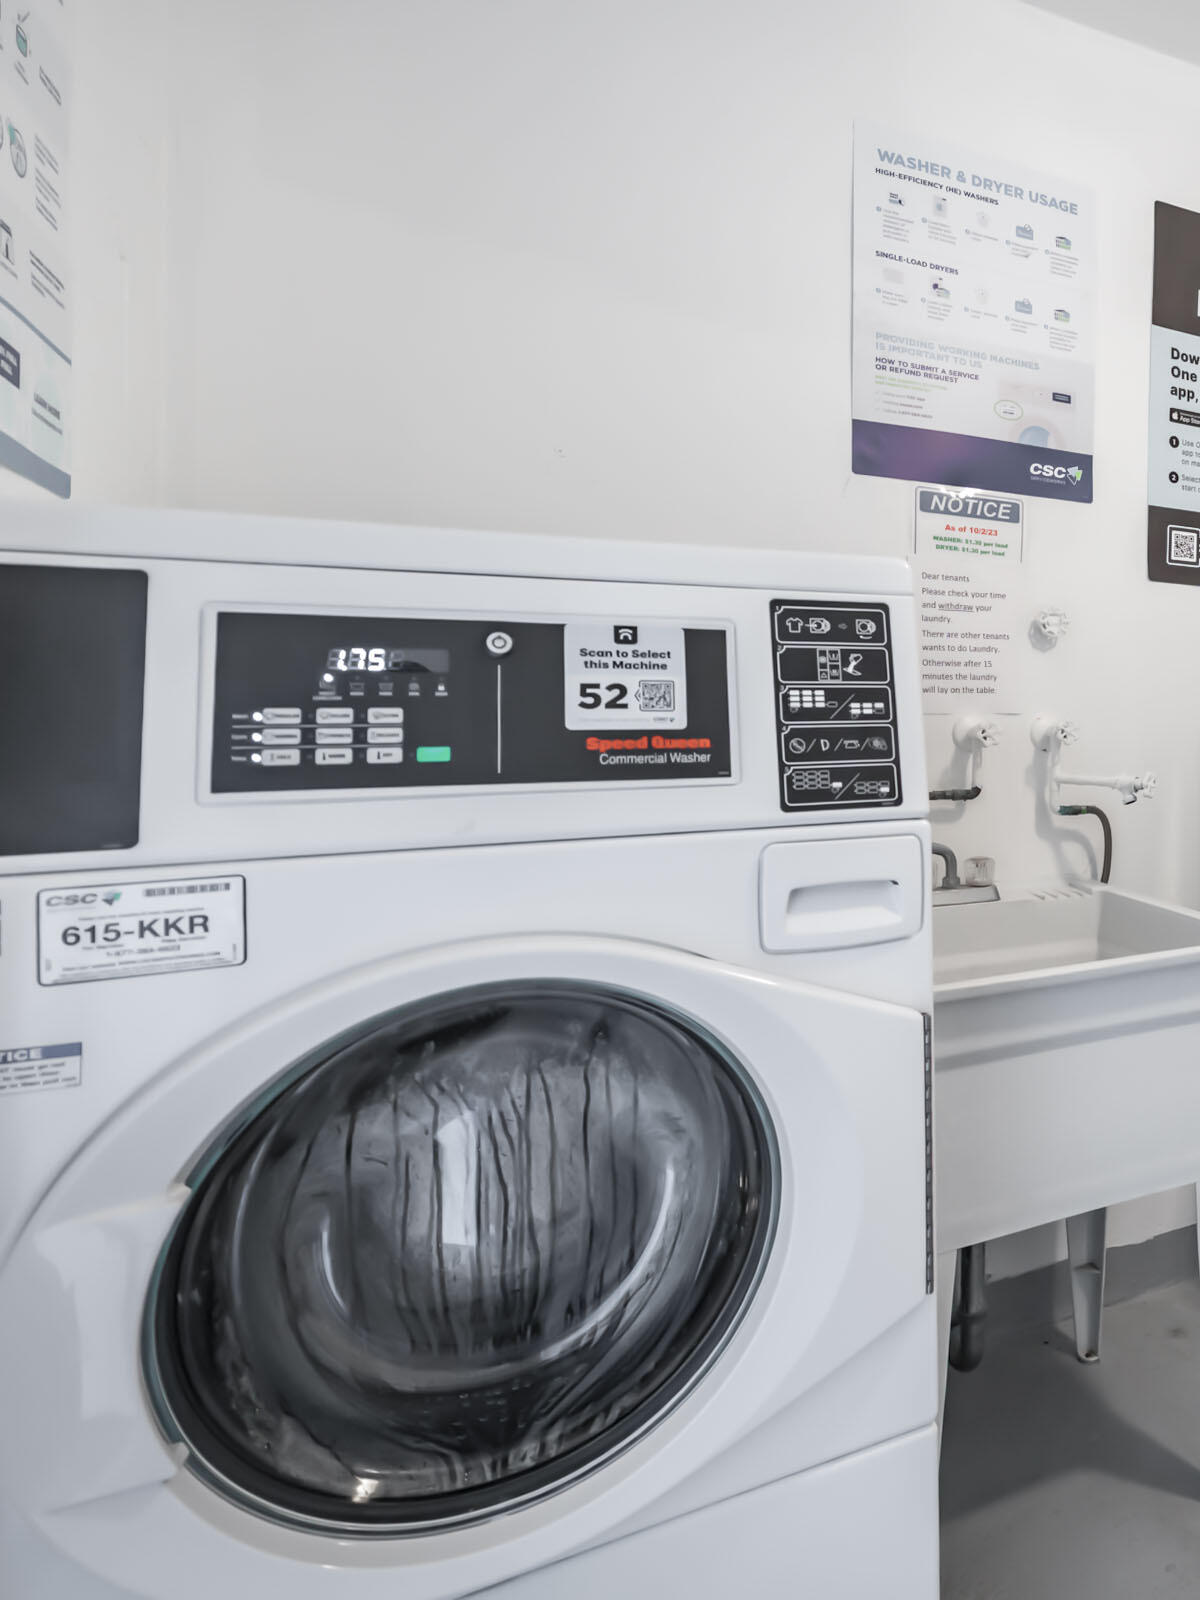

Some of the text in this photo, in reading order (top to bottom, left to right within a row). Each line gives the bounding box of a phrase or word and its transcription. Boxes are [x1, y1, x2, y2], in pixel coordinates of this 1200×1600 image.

[875, 167, 999, 206] HIGH-EFFICIENCY (HE) WASHERS
[877, 149, 1078, 215] WASHER & DRYER USAGE
[875, 250, 959, 275] SINGLE-LOAD DRYERS
[875, 332, 1040, 370] PROVIDING WORKING MACHINES
[875, 342, 983, 369] IS IMPORTANT TO US
[875, 356, 896, 365] HOW
[898, 360, 909, 368] TO
[910, 362, 939, 373] SUBMIT
[948, 369, 980, 381] SERVICE
[875, 364, 887, 372] OR
[889, 366, 922, 377] REFUND
[923, 372, 959, 384] REQUEST
[1170, 365, 1197, 382] One
[1170, 385, 1198, 403] app,
[1181, 440, 1194, 448] Use
[1029, 463, 1066, 478] CSC
[1181, 474, 1200, 483] Select
[930, 494, 1012, 519] NOTICE
[944, 523, 998, 537] As of 10/2/23
[933, 535, 963, 544] WASHER:
[935, 544, 960, 552] DRYER:
[921, 571, 970, 583] Dear tenants
[921, 588, 946, 596] Please
[947, 589, 969, 598] check
[971, 592, 988, 600] your
[921, 601, 992, 613] and withdraw your
[921, 630, 945, 638] There
[960, 631, 981, 639] other
[982, 632, 1010, 640] tenants
[579, 648, 671, 659] Scan to Select
[922, 644, 946, 652] wants
[947, 644, 956, 652] to
[957, 644, 968, 652] do
[584, 660, 668, 670] this Machine
[922, 659, 993, 668] Otherwise after 15
[922, 672, 997, 682] minutes the laundry
[577, 682, 629, 709] 52
[922, 685, 936, 694] will
[937, 685, 949, 695] lay
[962, 685, 975, 694] the
[585, 735, 712, 752] Speed Queen
[599, 752, 711, 765] Commercial Washer
[46, 893, 98, 907] CSC
[61, 914, 210, 947] 615-KKR
